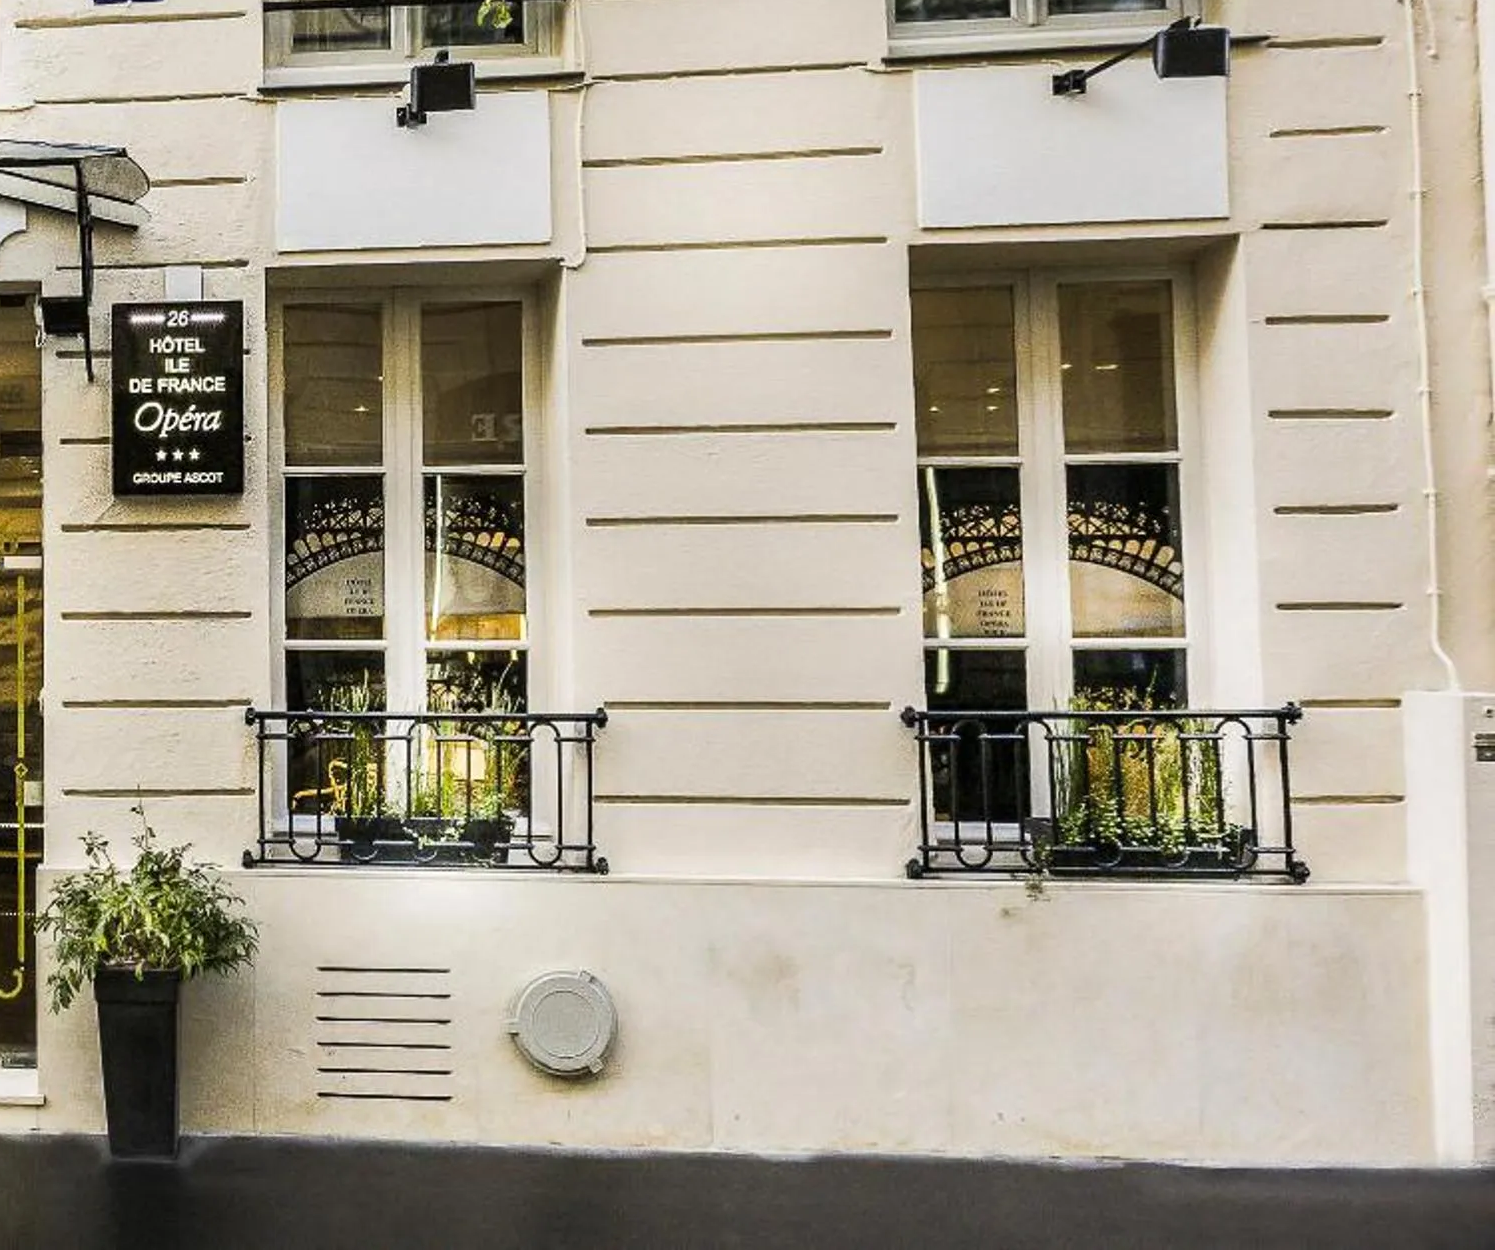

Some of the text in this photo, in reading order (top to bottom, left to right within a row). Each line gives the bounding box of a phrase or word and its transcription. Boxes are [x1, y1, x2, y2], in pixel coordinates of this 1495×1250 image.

[166, 310, 190, 328] 26
[149, 335, 206, 354] HÔTEL
[164, 357, 191, 374] ILE
[128, 376, 226, 394] DE FRANCE
[134, 401, 223, 439] Opéra
[132, 471, 224, 484] GROUPE ASCOT
